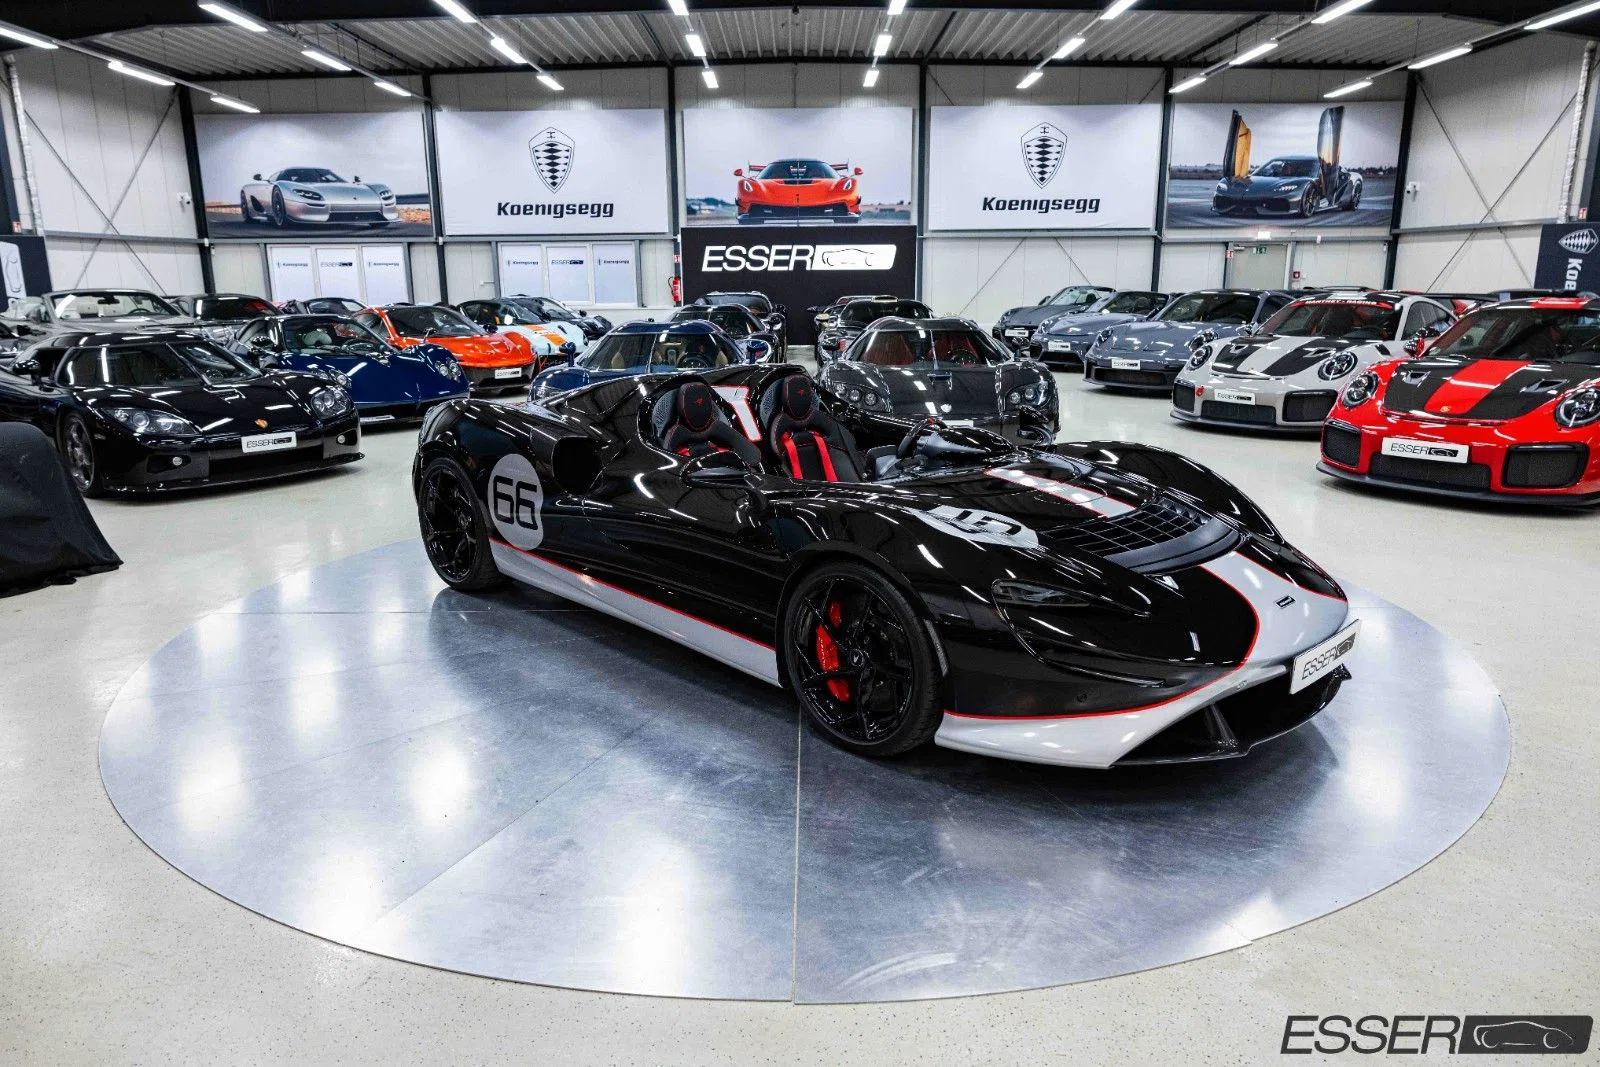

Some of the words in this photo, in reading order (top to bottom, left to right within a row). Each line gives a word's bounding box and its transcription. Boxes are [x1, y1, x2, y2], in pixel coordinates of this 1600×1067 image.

[497, 202, 614, 218] Koenigsegg
[982, 197, 1100, 213] Koenigsegg
[702, 245, 813, 271] ESSER
[1390, 443, 1430, 454] ESSER
[493, 474, 539, 530] 66
[1302, 646, 1338, 681] ESSER
